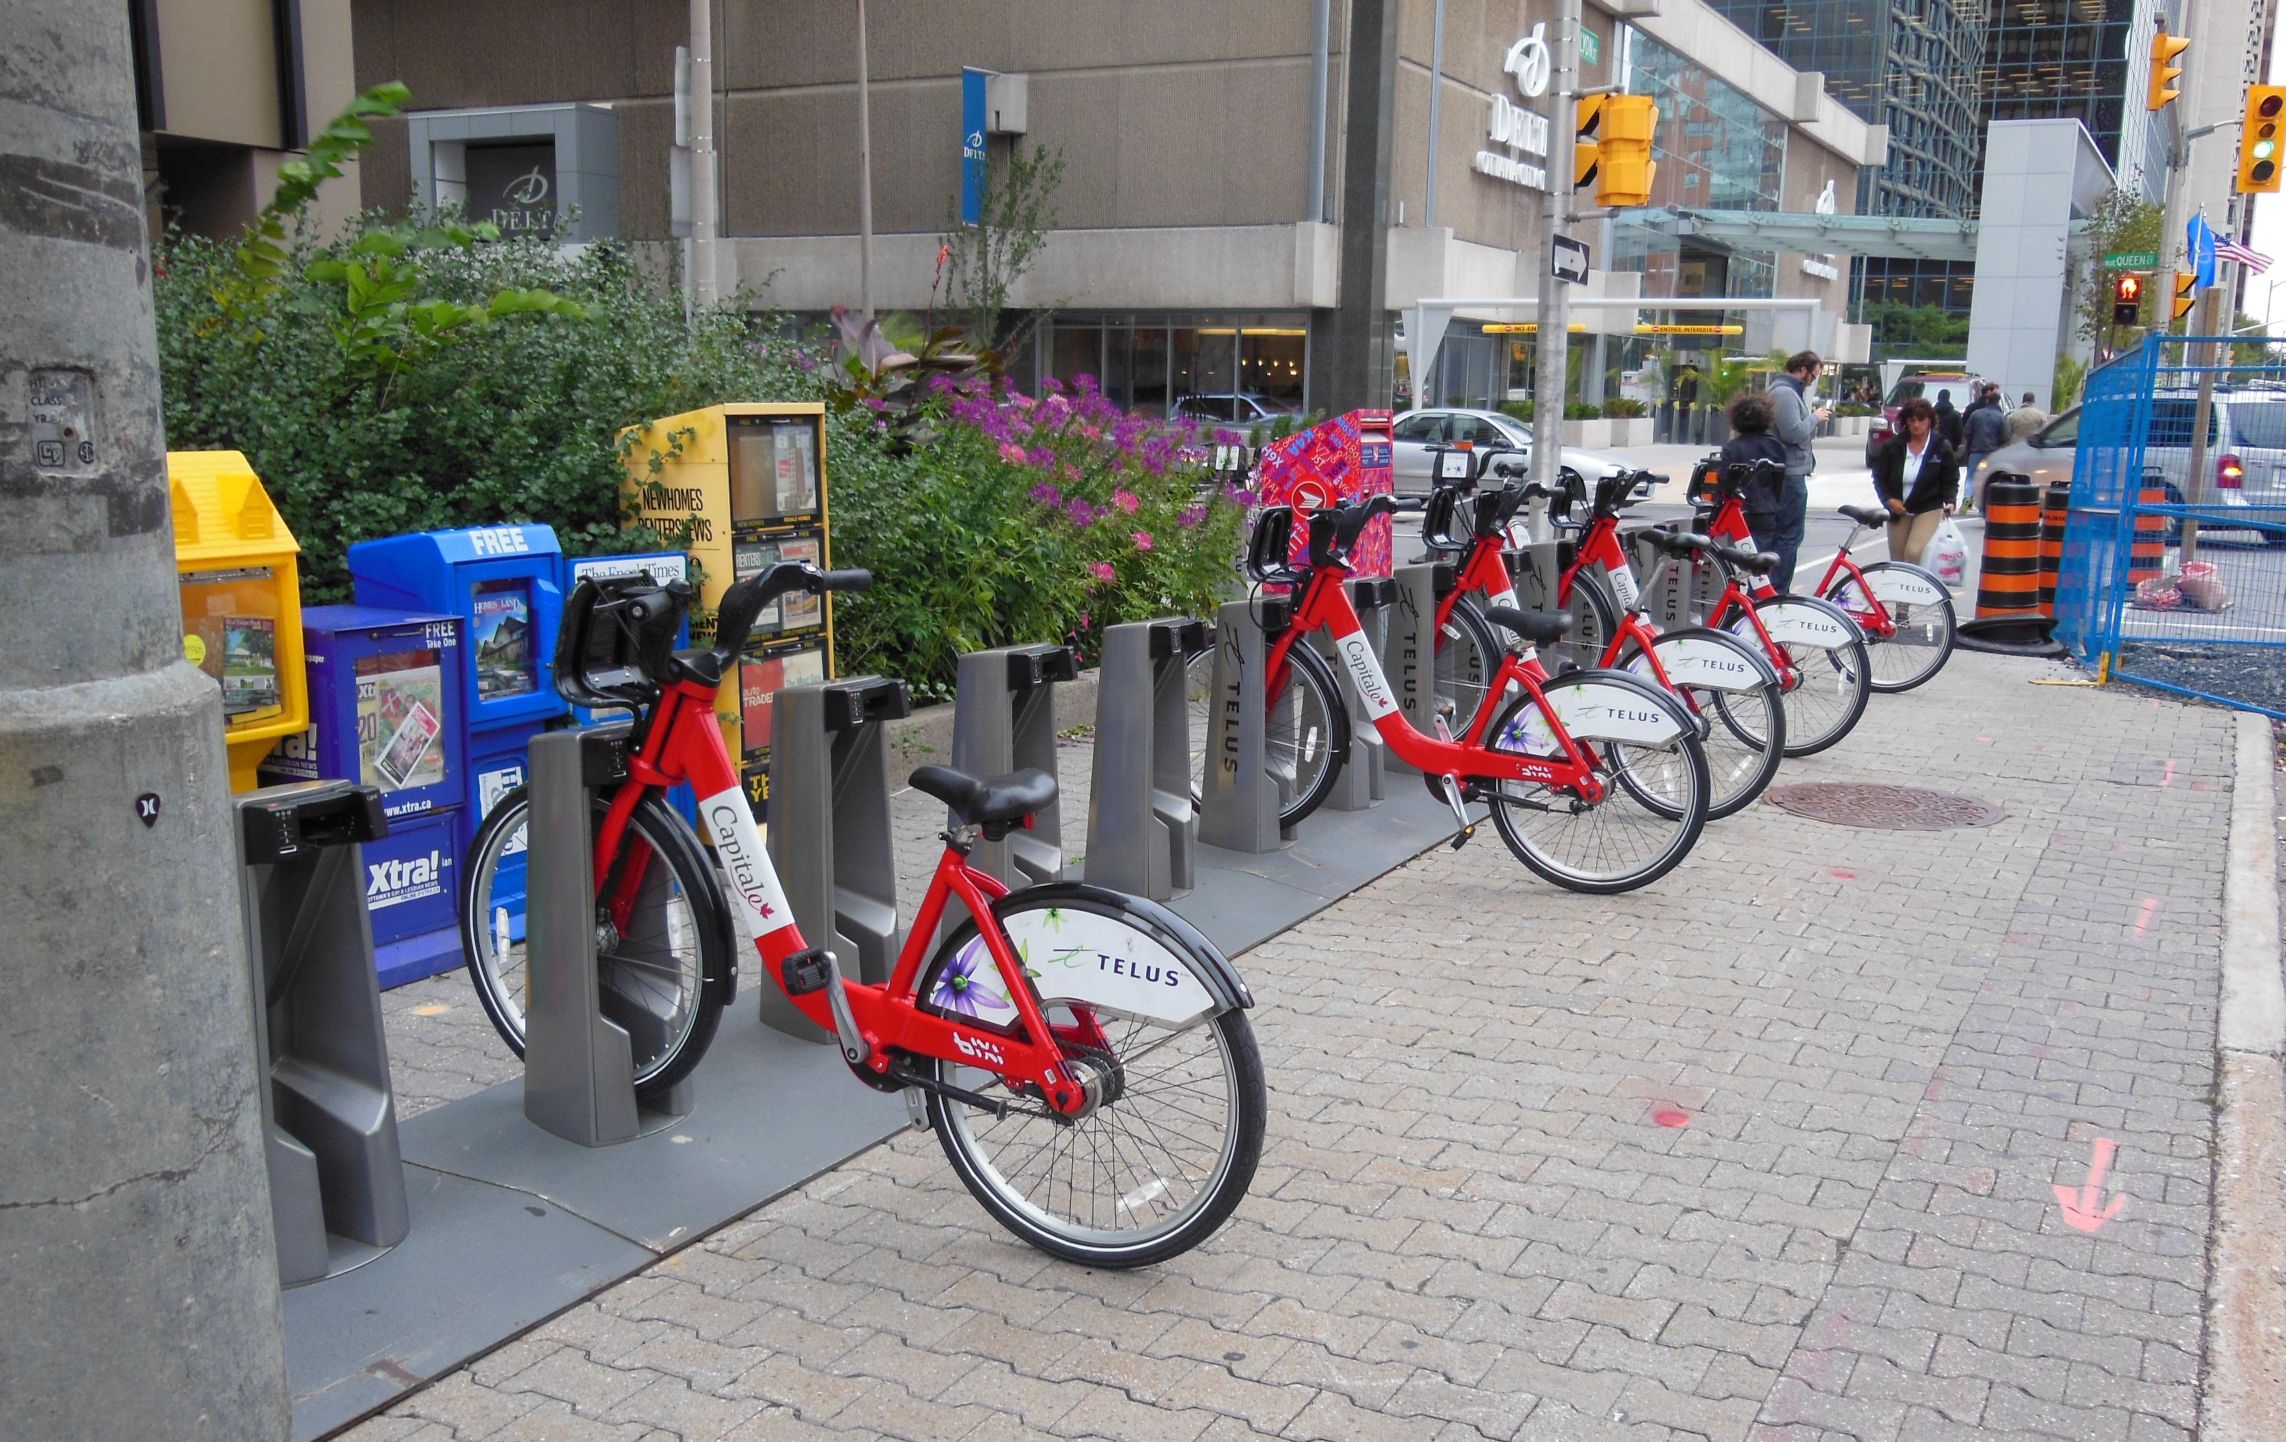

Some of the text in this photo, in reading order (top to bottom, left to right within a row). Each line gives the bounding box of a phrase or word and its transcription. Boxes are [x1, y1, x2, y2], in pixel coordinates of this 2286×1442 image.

[1490, 93, 1549, 157] DELT
[2116, 255, 2146, 267] QUEEN
[1514, 324, 1526, 333] NO
[1261, 445, 1284, 468] H9X
[469, 528, 529, 555] FREE
[645, 562, 679, 579] Times
[1666, 566, 1678, 621] TELUS
[1901, 584, 1931, 594] TELUS
[425, 622, 455, 639] FREE
[1799, 621, 1837, 633] TELUS
[426, 637, 457, 649] Take One
[1346, 640, 1381, 702] Capitale
[1404, 633, 1416, 710] TELUS
[1702, 659, 1745, 672] TELUS
[1607, 708, 1660, 723] TELUS
[1224, 681, 1240, 774] TELUS
[712, 805, 764, 909] Capitale
[367, 850, 439, 896] Xtra!
[1097, 954, 1179, 987] TELUS
